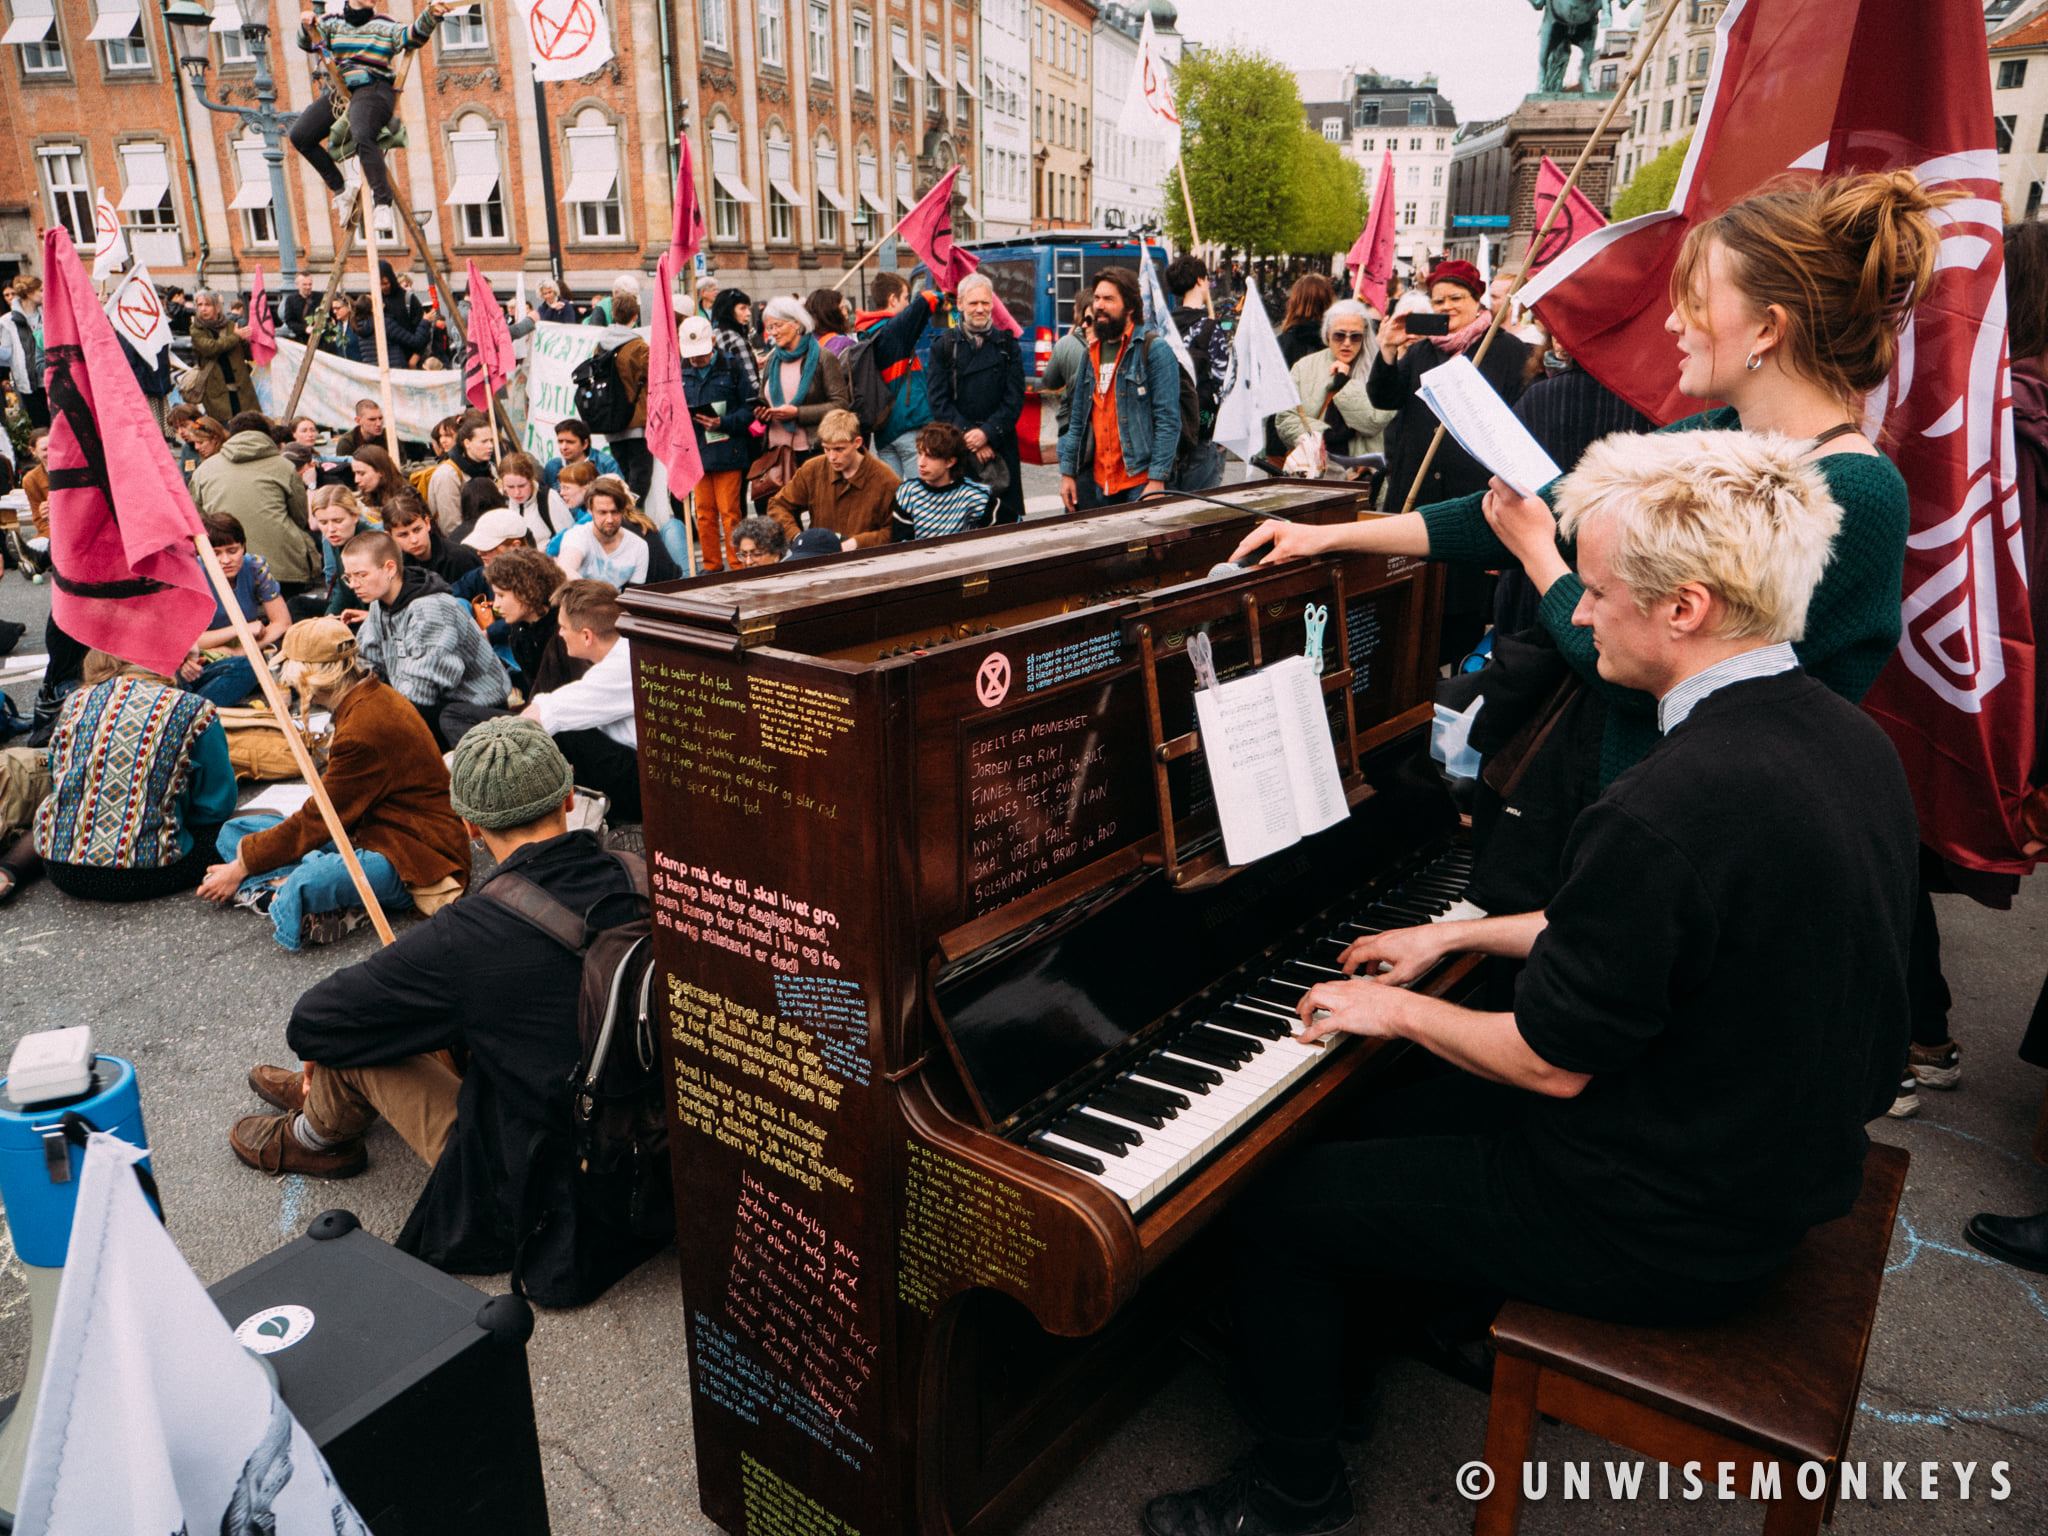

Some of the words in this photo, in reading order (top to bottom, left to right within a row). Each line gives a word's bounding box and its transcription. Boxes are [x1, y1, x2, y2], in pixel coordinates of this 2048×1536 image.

[688, 689, 695, 701] af
[700, 672, 713, 687] din
[660, 732, 676, 745] man
[740, 756, 776, 773] minder
[708, 726, 736, 740] finder
[972, 736, 1007, 758] EDELT
[1012, 729, 1025, 744] ER
[1031, 715, 1088, 738] MENNESKET
[736, 775, 753, 787] eller
[783, 791, 791, 808] og
[972, 760, 1013, 779] JORDEN
[1018, 755, 1033, 768] ER
[1017, 773, 1038, 792] HER
[974, 801, 1019, 831] SKYLDES
[1026, 788, 1049, 810] DET
[1033, 859, 1048, 874] OG
[1098, 821, 1116, 841] ÅND
[653, 872, 664, 890] ej
[666, 874, 698, 901] kamp
[700, 886, 725, 909] blot
[727, 895, 745, 914] for
[748, 904, 792, 933] dagligt
[794, 918, 829, 947] brød,
[655, 851, 688, 877] Kamp
[691, 867, 710, 883] må
[712, 871, 732, 889] der
[735, 879, 750, 899] til,
[754, 885, 778, 906] skal
[782, 893, 810, 917] livet
[813, 908, 840, 930] gro,
[655, 893, 679, 912] men
[682, 899, 714, 926] kamp
[717, 911, 735, 931] for
[737, 919, 772, 945] frihed
[776, 933, 780, 948] i
[783, 935, 798, 954] liv
[802, 946, 819, 965] og
[656, 910, 672, 928] thi
[675, 920, 699, 942] evig
[702, 928, 751, 957] stilstand
[754, 949, 768, 963] er
[667, 973, 722, 1009] Egetræet
[725, 997, 759, 1025] tungt
[762, 1015, 776, 1030] af
[779, 1022, 814, 1046] alder
[669, 989, 708, 1019] rådner
[711, 1009, 726, 1027] på
[729, 1019, 748, 1036] sin
[751, 1029, 773, 1048] rod
[776, 1040, 792, 1060] og
[670, 1011, 684, 1028] og
[688, 1015, 705, 1035] for
[708, 1024, 799, 1077] flammestorme
[803, 1065, 844, 1095] falder
[672, 1027, 709, 1055] skove,
[712, 1045, 738, 1066] som
[742, 1059, 764, 1078] gav
[768, 1069, 815, 1102] skygge
[818, 1091, 839, 1111] før
[675, 1057, 700, 1081] Hval
[710, 1074, 732, 1096] hav
[736, 1090, 751, 1108] og
[754, 1095, 777, 1118] fisk
[781, 1108, 785, 1122] i
[789, 1112, 828, 1140] floder
[676, 1075, 719, 1107] dræbes
[723, 1099, 735, 1113] af
[737, 1106, 758, 1124] vor
[761, 1119, 823, 1158] overmagt
[678, 1106, 698, 1127] har
[701, 1119, 712, 1135] til
[716, 1127, 742, 1150] dom
[746, 1143, 756, 1158] vi
[760, 1150, 822, 1191] overbragt
[783, 1145, 804, 1164] vor
[808, 1158, 854, 1192] moder,
[933, 1154, 943, 1163] EN
[739, 1190, 769, 1222] Jorden
[772, 1219, 784, 1230] er
[786, 1229, 797, 1245] en
[801, 1237, 826, 1271] herlig
[833, 1263, 858, 1291] jord
[743, 1169, 765, 1195] Livet
[768, 1192, 780, 1204] er
[781, 1202, 794, 1217] en
[796, 1208, 826, 1246] dejlig
[834, 1240, 860, 1267] gave
[737, 1204, 753, 1223] Der
[754, 1223, 766, 1234] er
[795, 1254, 798, 1266] i
[804, 1264, 824, 1284] min
[830, 1284, 858, 1313] mave
